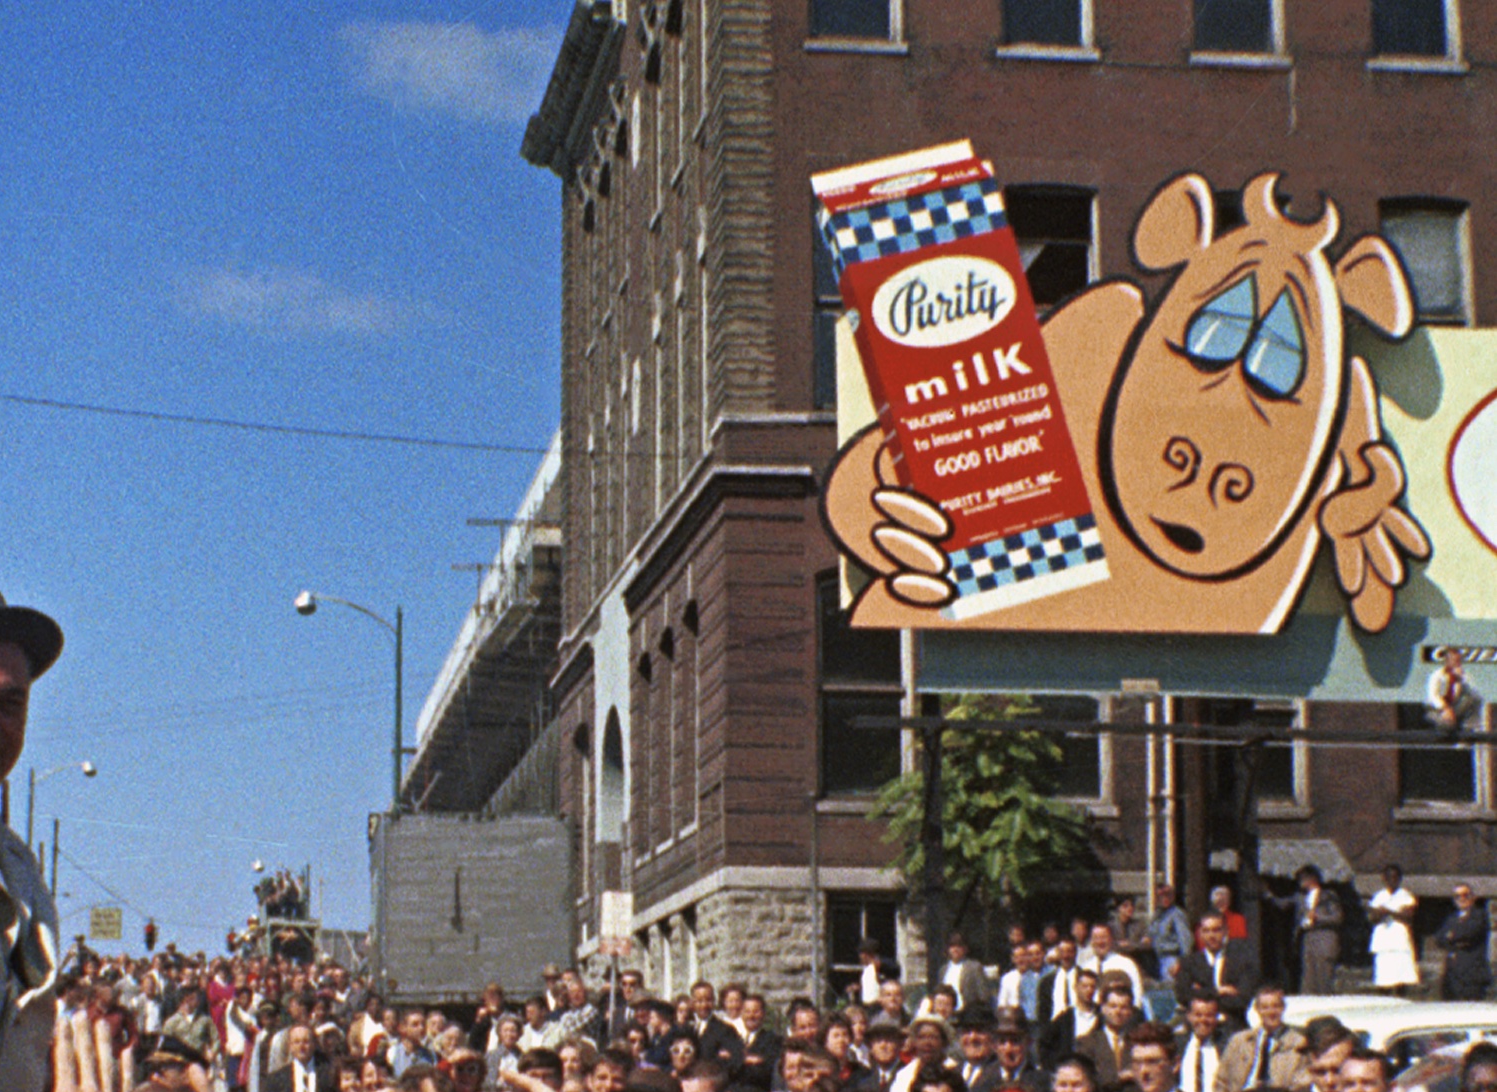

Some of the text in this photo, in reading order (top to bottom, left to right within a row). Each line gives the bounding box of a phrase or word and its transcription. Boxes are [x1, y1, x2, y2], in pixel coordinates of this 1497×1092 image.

[890, 270, 1006, 336] Purity
[961, 383, 1049, 417] PASTEURIZED
[913, 438, 930, 452] to
[931, 427, 973, 448] insure
[977, 418, 1007, 439] year
[933, 450, 981, 477] GOOD
